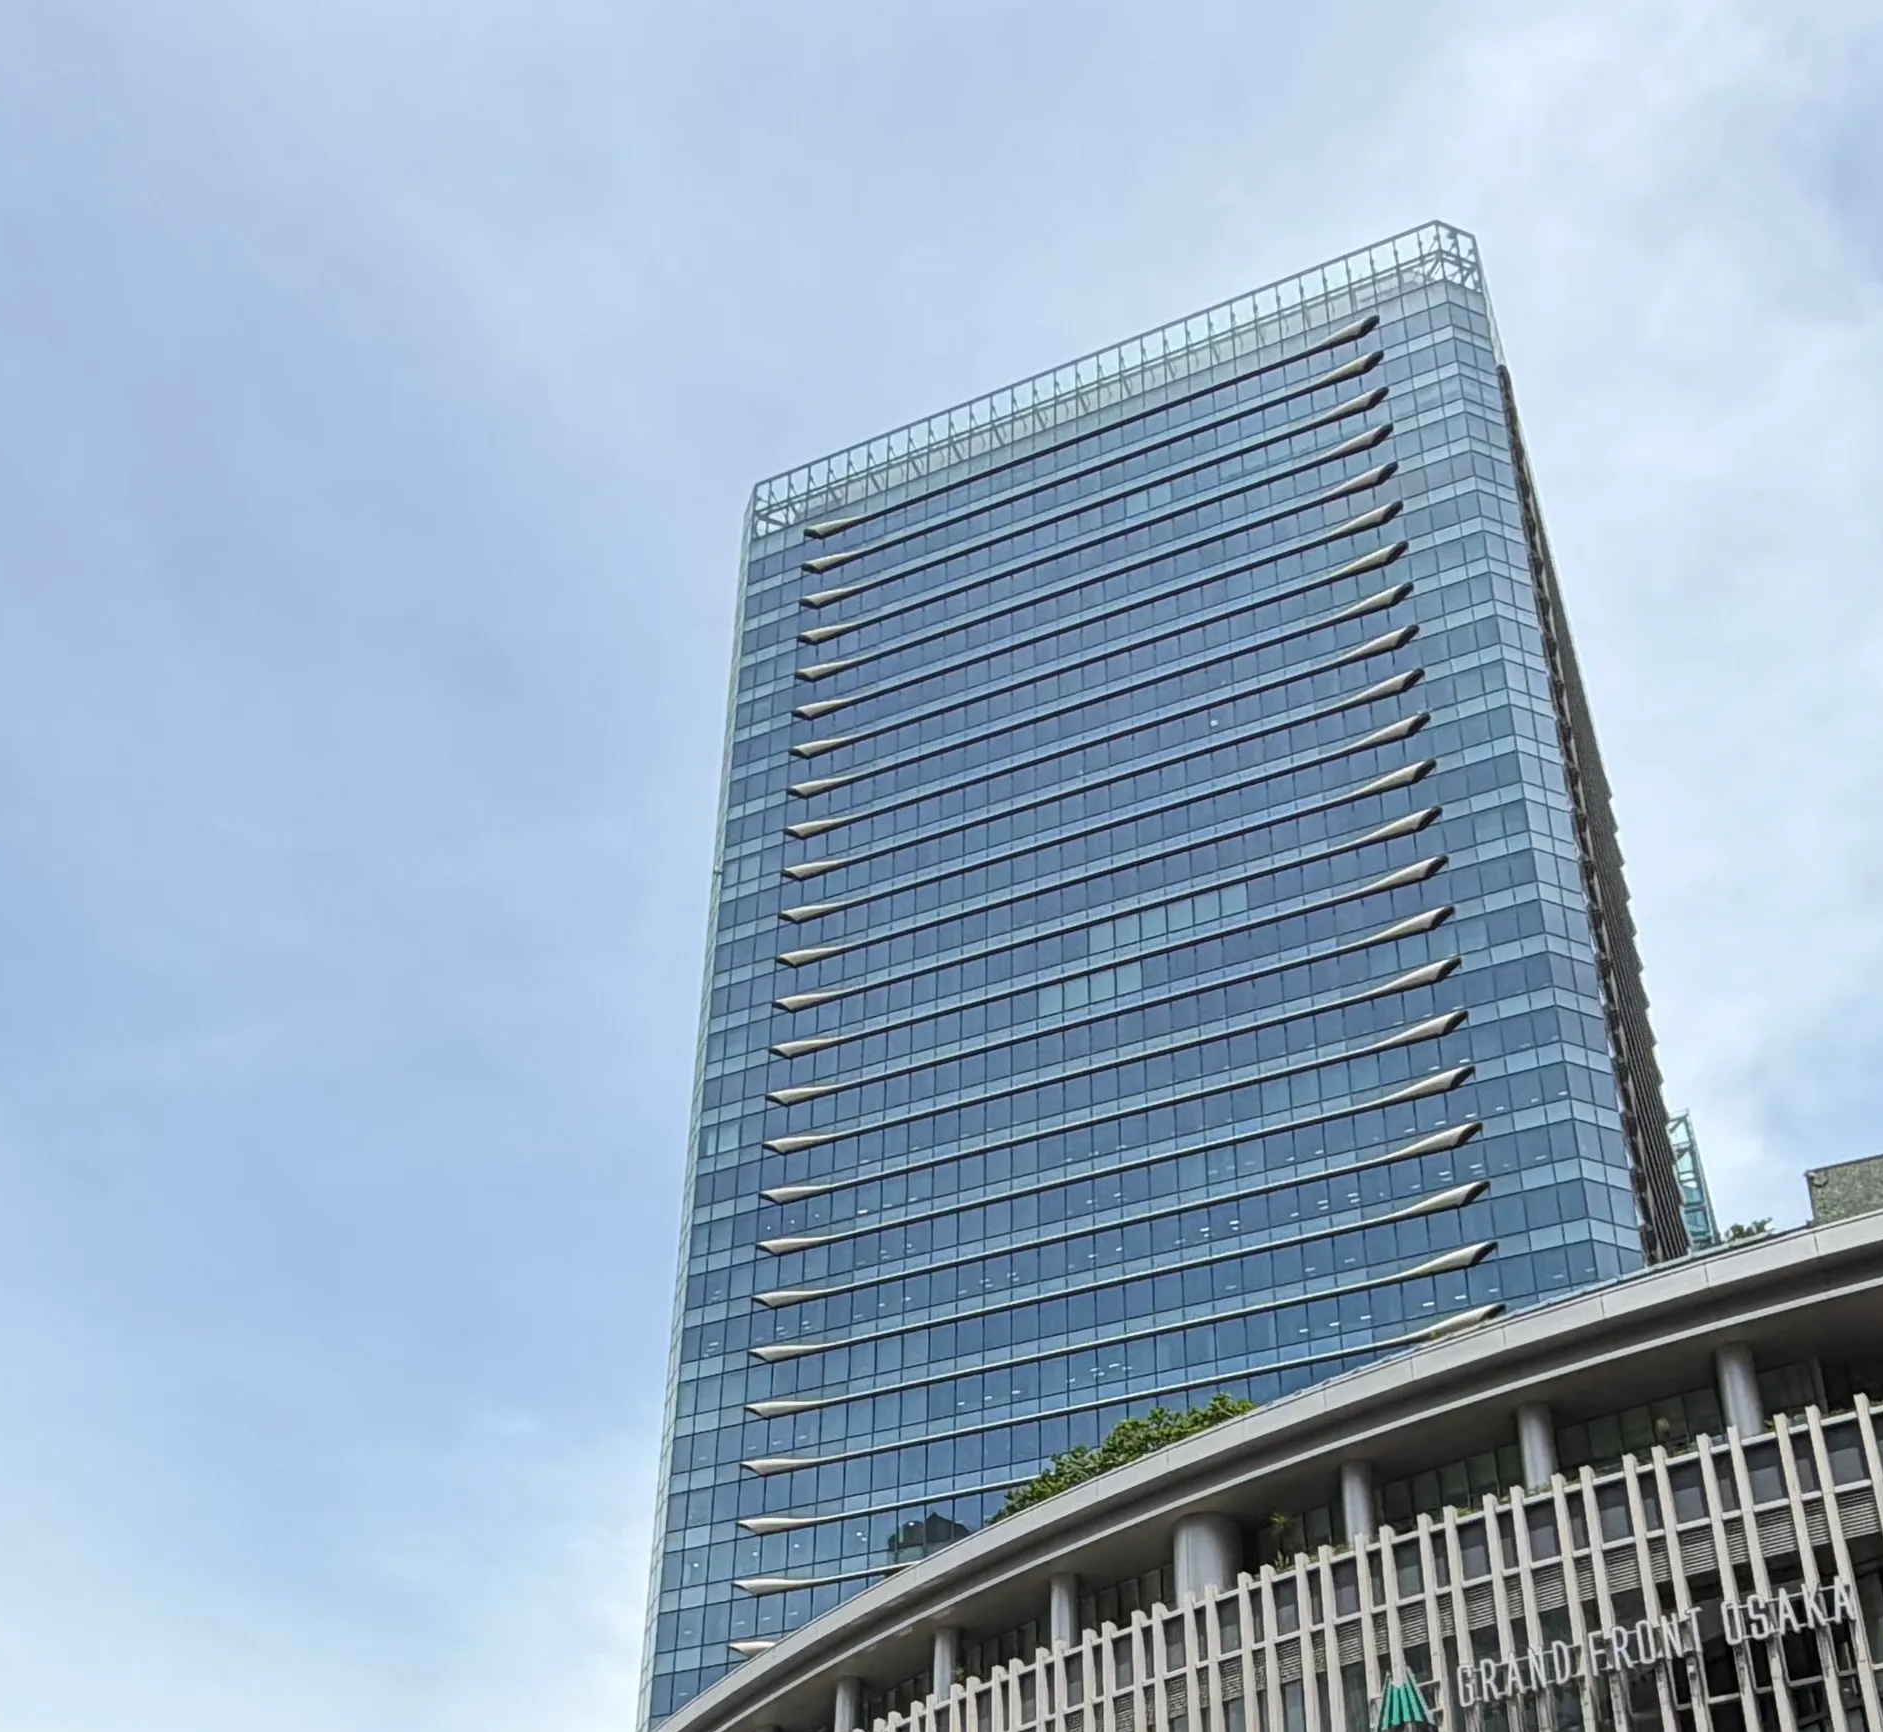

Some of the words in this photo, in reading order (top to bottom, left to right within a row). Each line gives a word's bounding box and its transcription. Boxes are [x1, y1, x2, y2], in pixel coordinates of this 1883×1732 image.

[1456, 1638, 1572, 1708] GRAND
[1587, 1607, 1703, 1675] FRONT
[1720, 1577, 1857, 1645] OSAKA
